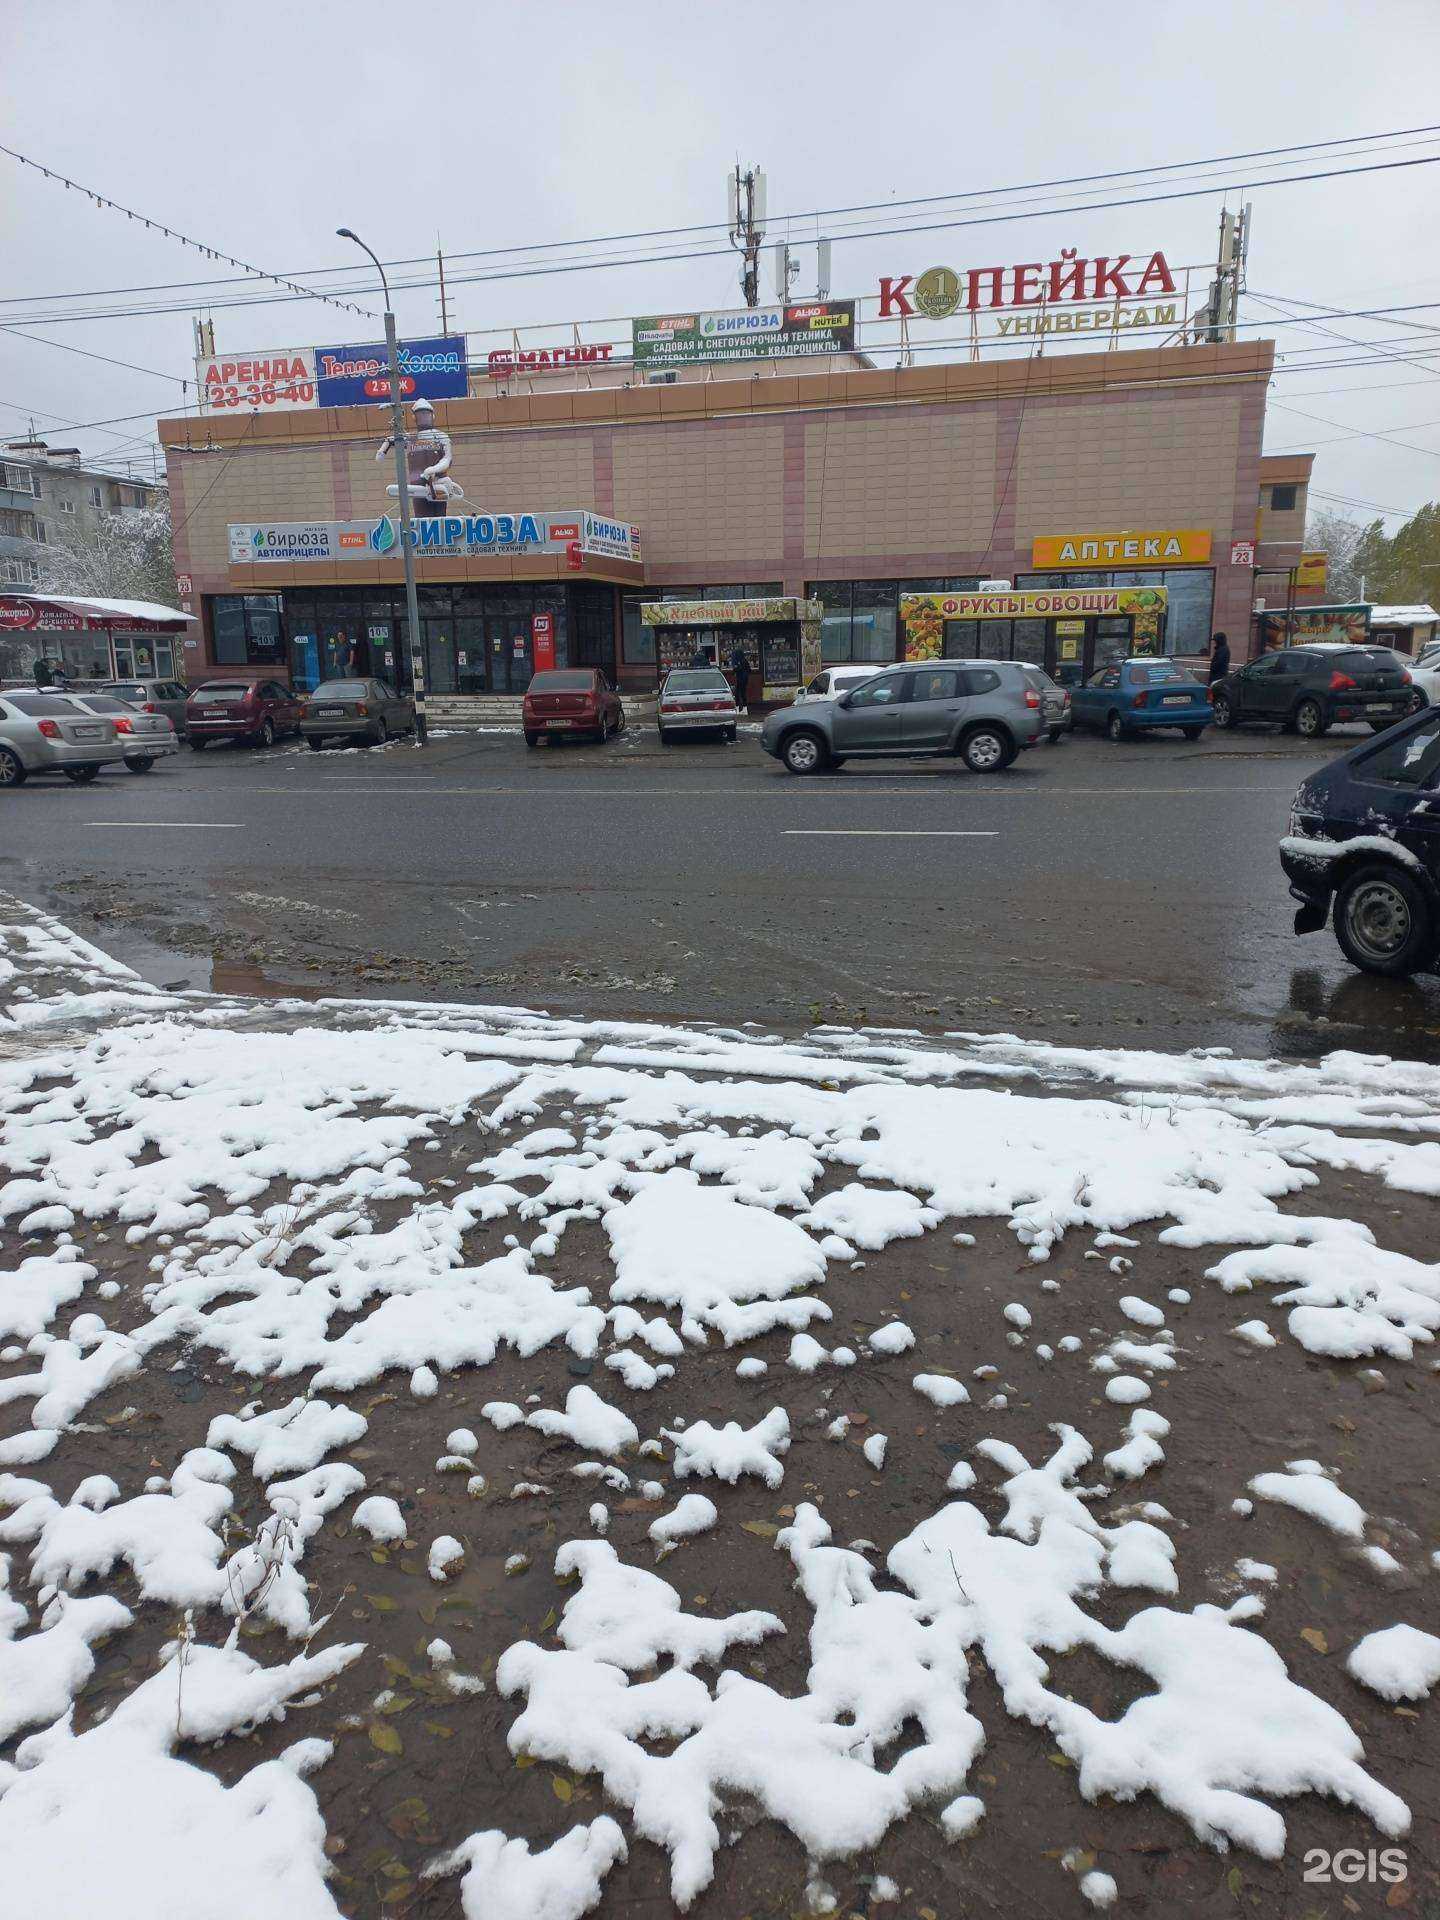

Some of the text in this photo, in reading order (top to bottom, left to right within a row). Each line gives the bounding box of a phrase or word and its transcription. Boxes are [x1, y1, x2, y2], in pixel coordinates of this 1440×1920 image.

[660, 319, 691, 330] STIHL
[717, 313, 780, 331] БИРЮЗА
[996, 303, 1177, 337] УНИВЕРСАМ
[653, 329, 833, 353] САДОВАЯ И СНЕГОУБОРОЧНАЯ ТЕХНИКА
[768, 340, 841, 358] КВАДРОЦИКЛЫ
[396, 349, 460, 375] Холод
[516, 345, 613, 371] МАГНИТ
[205, 358, 308, 384] АРЕНДА
[381, 379, 408, 392] этж
[267, 531, 329, 548] бирюза
[400, 514, 538, 547] БИРЮЗА
[594, 521, 627, 543] БИРЮЗА
[257, 548, 330, 558] АВТОПРИЦЕПЫ
[1059, 538, 1182, 561] АПТЕКА
[1235, 552, 1249, 562] 23
[181, 582, 190, 592] 23
[942, 594, 1119, 614] ФРУКТЫ-ОВОЩИ
